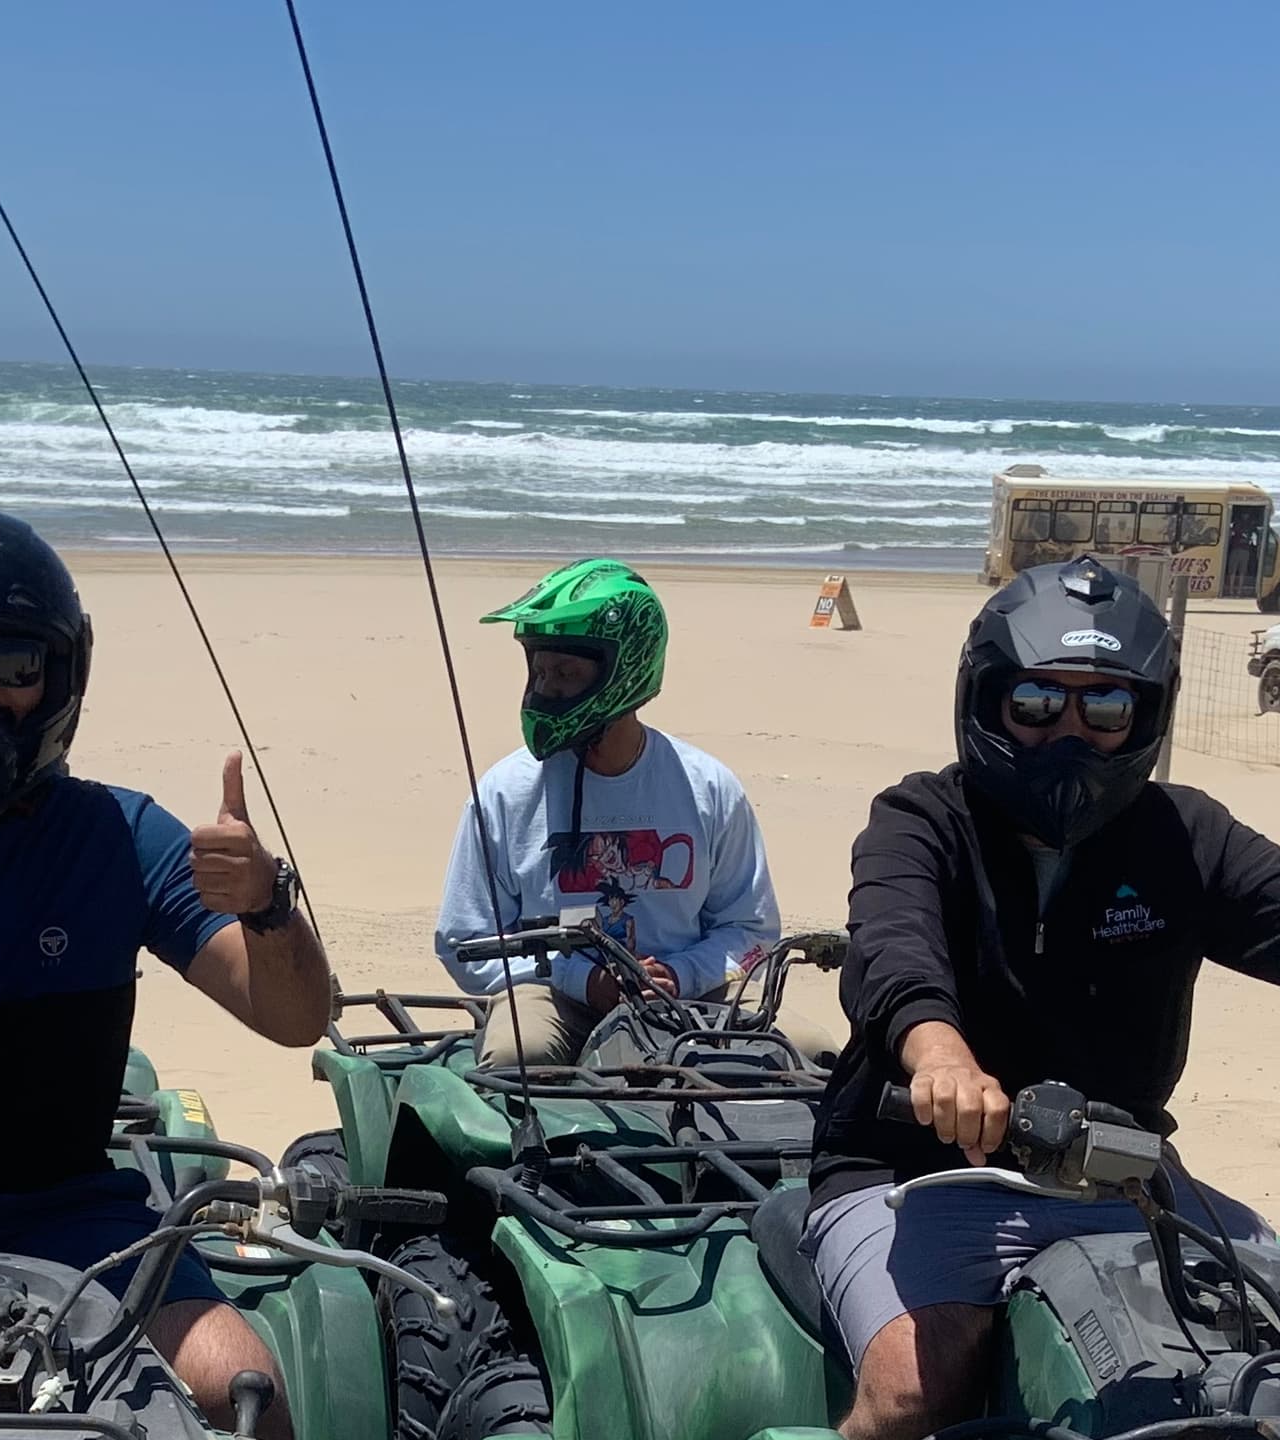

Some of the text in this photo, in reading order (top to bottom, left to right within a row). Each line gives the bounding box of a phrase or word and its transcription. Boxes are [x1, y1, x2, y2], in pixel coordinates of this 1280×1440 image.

[1105, 904, 1151, 923] Family
[1092, 919, 1165, 940] HealthCare
[1075, 1312, 1120, 1378] YAMAHA
